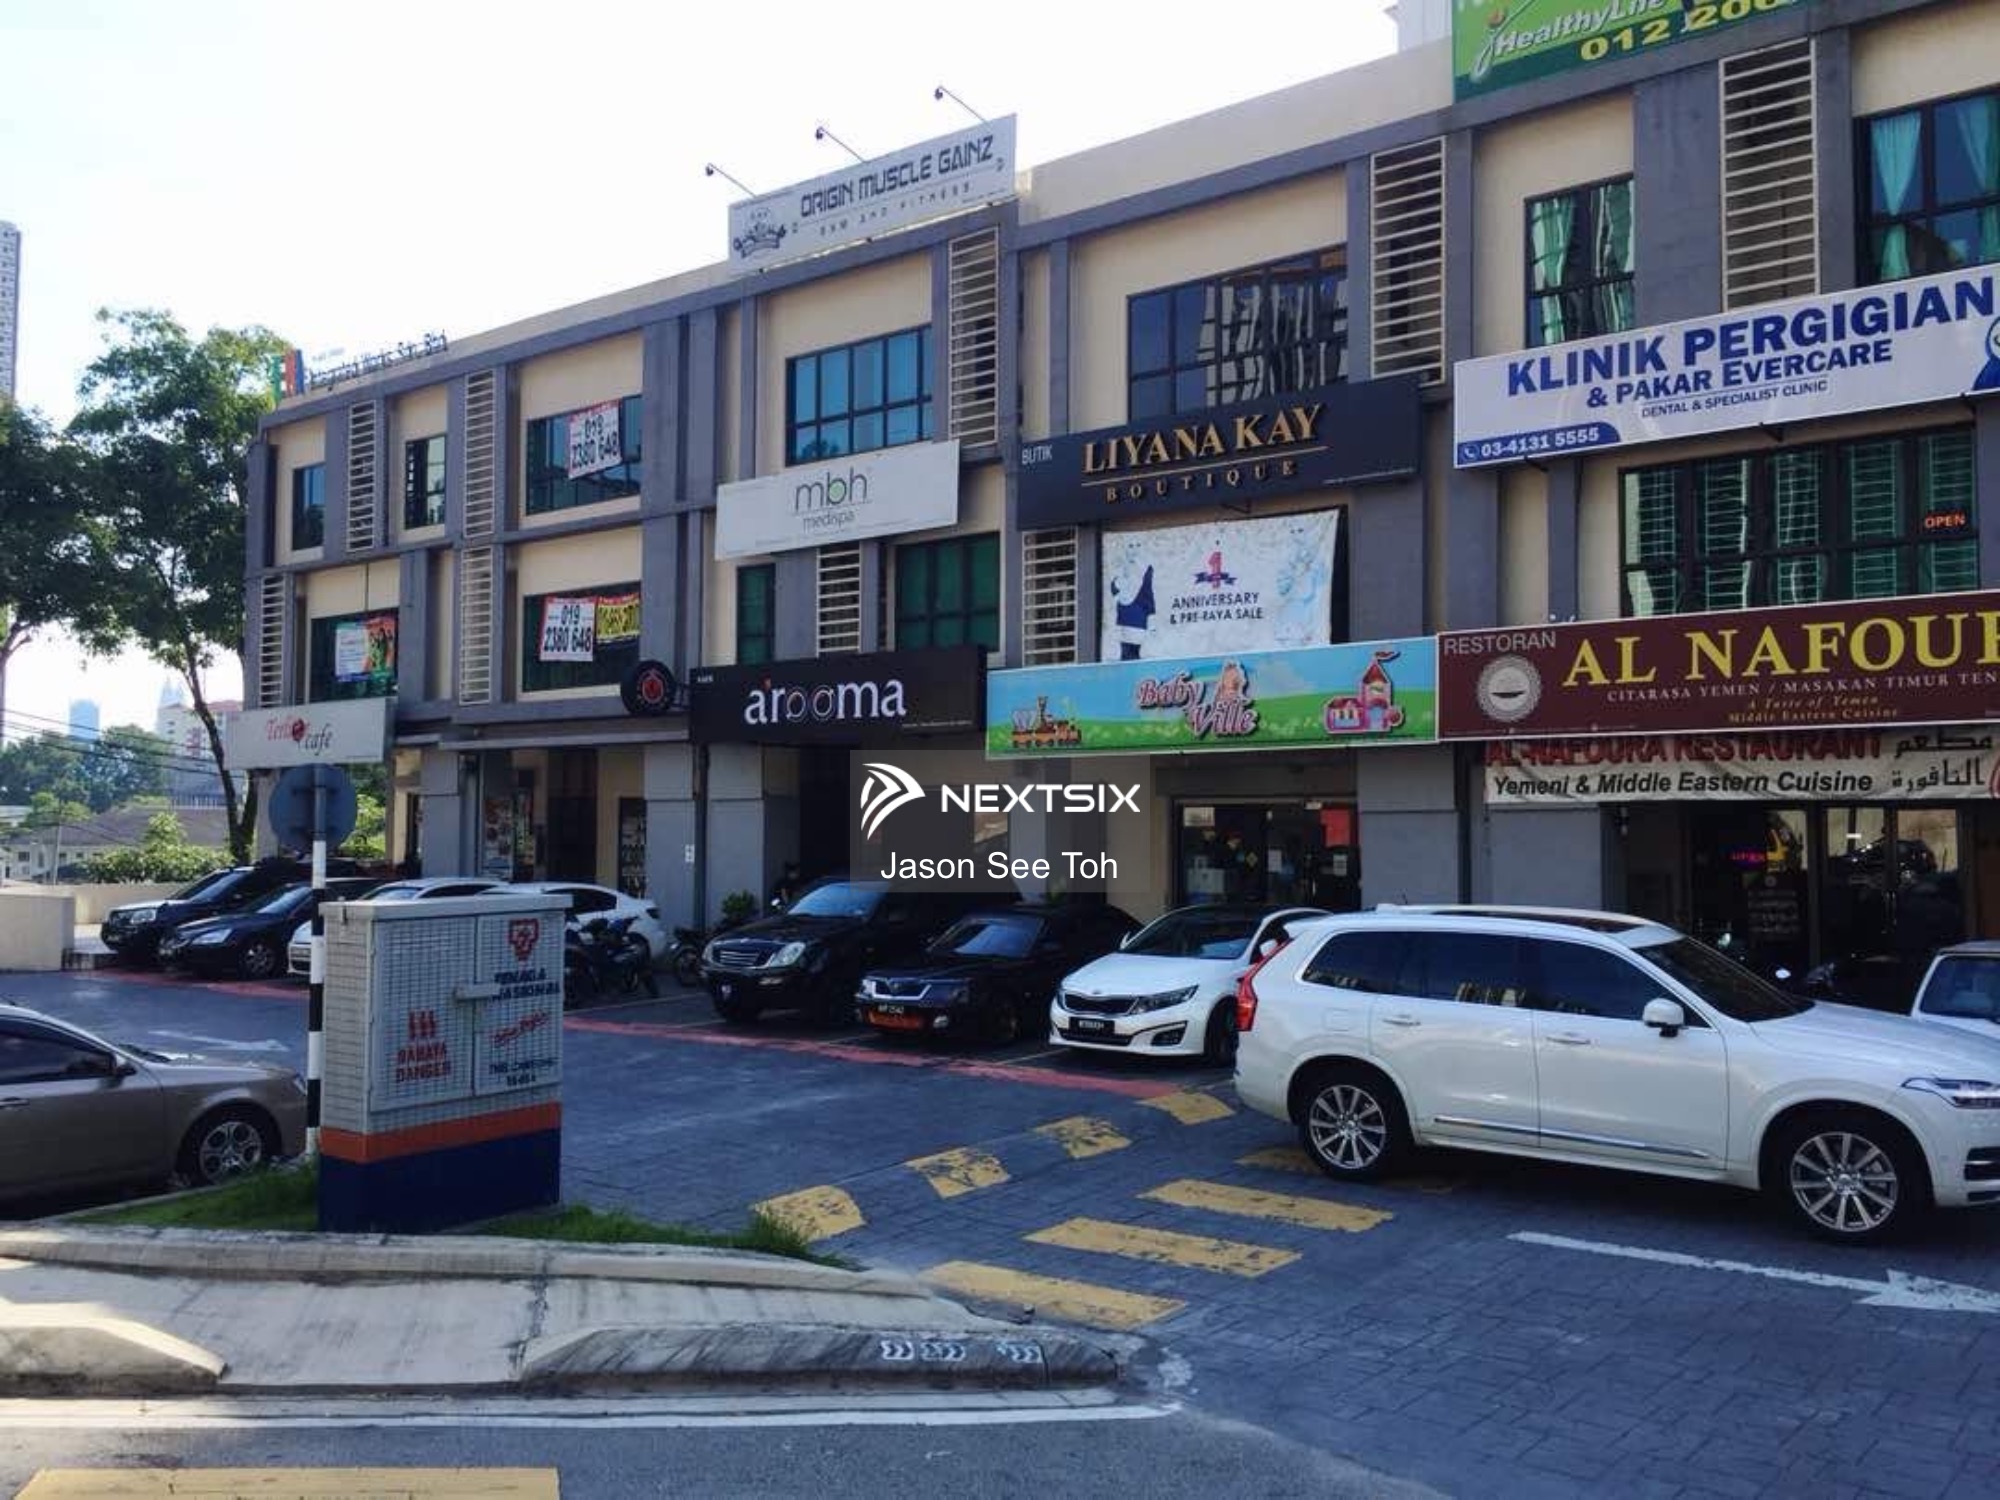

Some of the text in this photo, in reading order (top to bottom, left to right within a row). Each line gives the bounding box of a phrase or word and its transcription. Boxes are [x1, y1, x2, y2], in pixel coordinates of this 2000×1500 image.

[1580, 19, 1670, 61] 012
[801, 135, 993, 217] ORIGIN MUSCLE GAINZ
[1508, 277, 1994, 397] KLINIK PERGIGIAN
[1586, 339, 1893, 408] & PAKAR EVERCARE
[1642, 379, 1828, 418] DENTAL & SPECIALIST CLINIC
[1082, 402, 1322, 474] LIYANA KAY
[1480, 426, 1601, 457] 03-4131 5555
[1022, 446, 1053, 465] BUTIK
[795, 465, 868, 513] mbh
[1106, 460, 1297, 502] BOUTIQUE
[1925, 515, 1966, 529] OPEN
[561, 604, 582, 625] 019
[1172, 592, 1260, 610] ANNIVERSARY
[1236, 607, 1264, 620] SALE
[543, 625, 593, 653] 2380 648
[1443, 631, 1557, 655] RESTORAN
[1562, 636, 1657, 687] AL
[744, 678, 907, 726] arooma
[1607, 687, 1691, 703] CITARASA
[1700, 683, 1761, 697] YEMEN
[1783, 677, 1877, 693] MASAKAN
[1886, 673, 1950, 689] TIMUR
[1834, 695, 1879, 706] Yemen
[1185, 698, 1258, 737] Ville
[1729, 707, 1898, 722] Middle Eastern Cuisine
[1893, 727, 1994, 760] مطعم
[1495, 769, 1873, 796] Yemeni & Middle Eastern Cuisine
